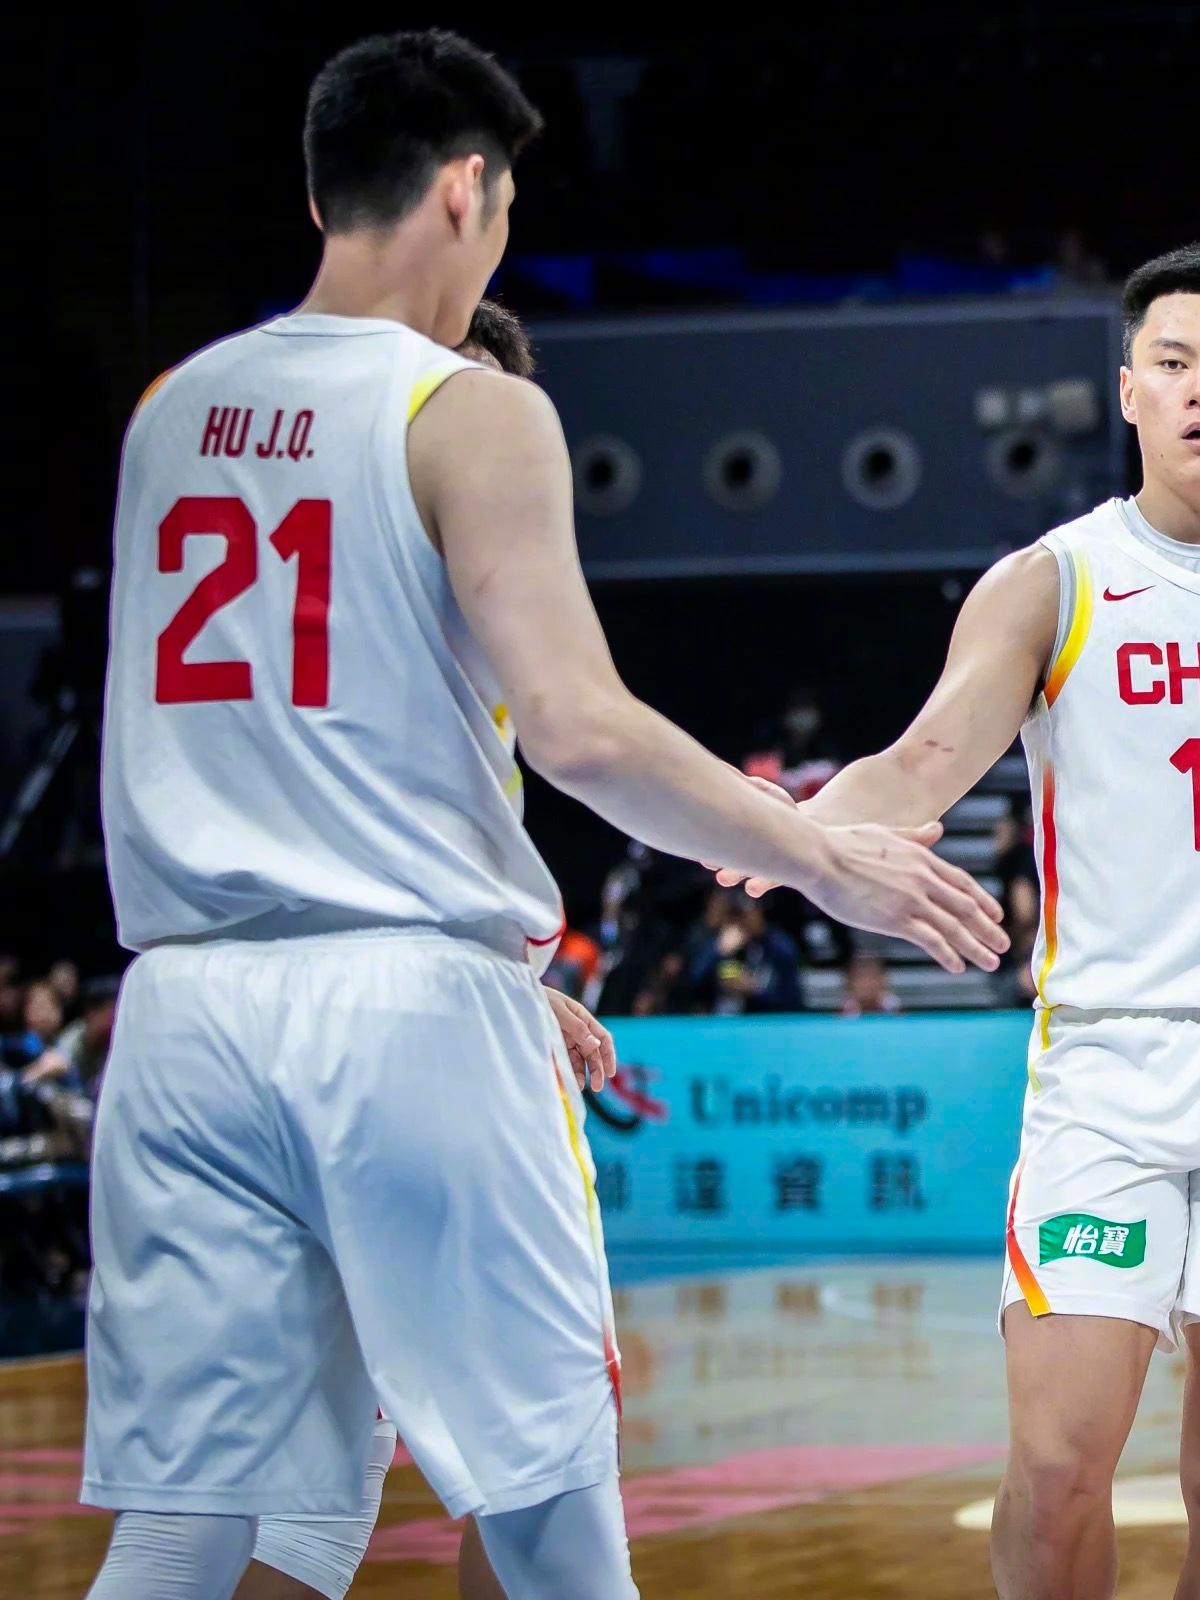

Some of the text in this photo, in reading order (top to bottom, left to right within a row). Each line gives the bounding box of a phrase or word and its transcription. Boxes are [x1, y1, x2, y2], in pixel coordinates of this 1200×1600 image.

[200, 406, 315, 461] HU J.Q.
[155, 496, 333, 708] 21
[689, 1073, 928, 1134] Unicomp
[1062, 1224, 1130, 1257] 怡寶
